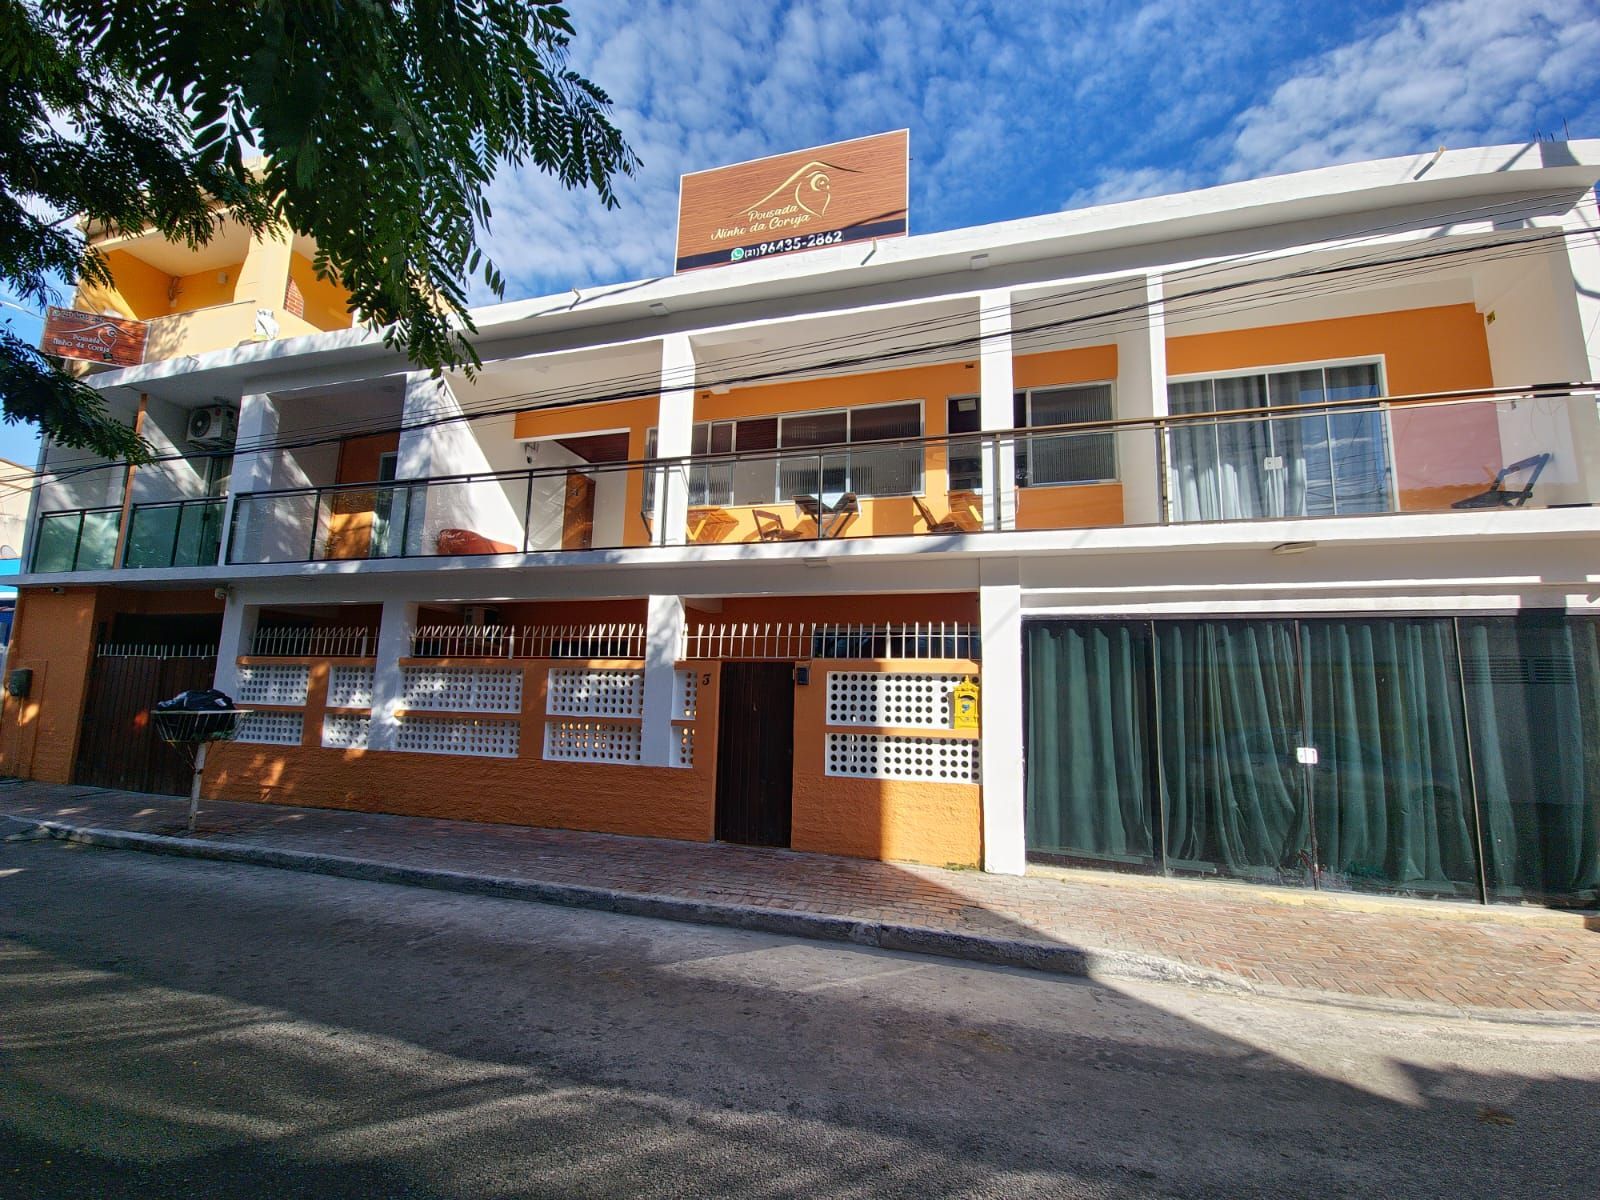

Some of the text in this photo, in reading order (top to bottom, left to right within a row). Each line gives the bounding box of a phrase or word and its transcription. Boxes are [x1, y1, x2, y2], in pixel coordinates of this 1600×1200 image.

[747, 204, 798, 222] Pousada
[711, 213, 811, 240] Ninho da Coruja
[703, 673, 711, 686] 3
